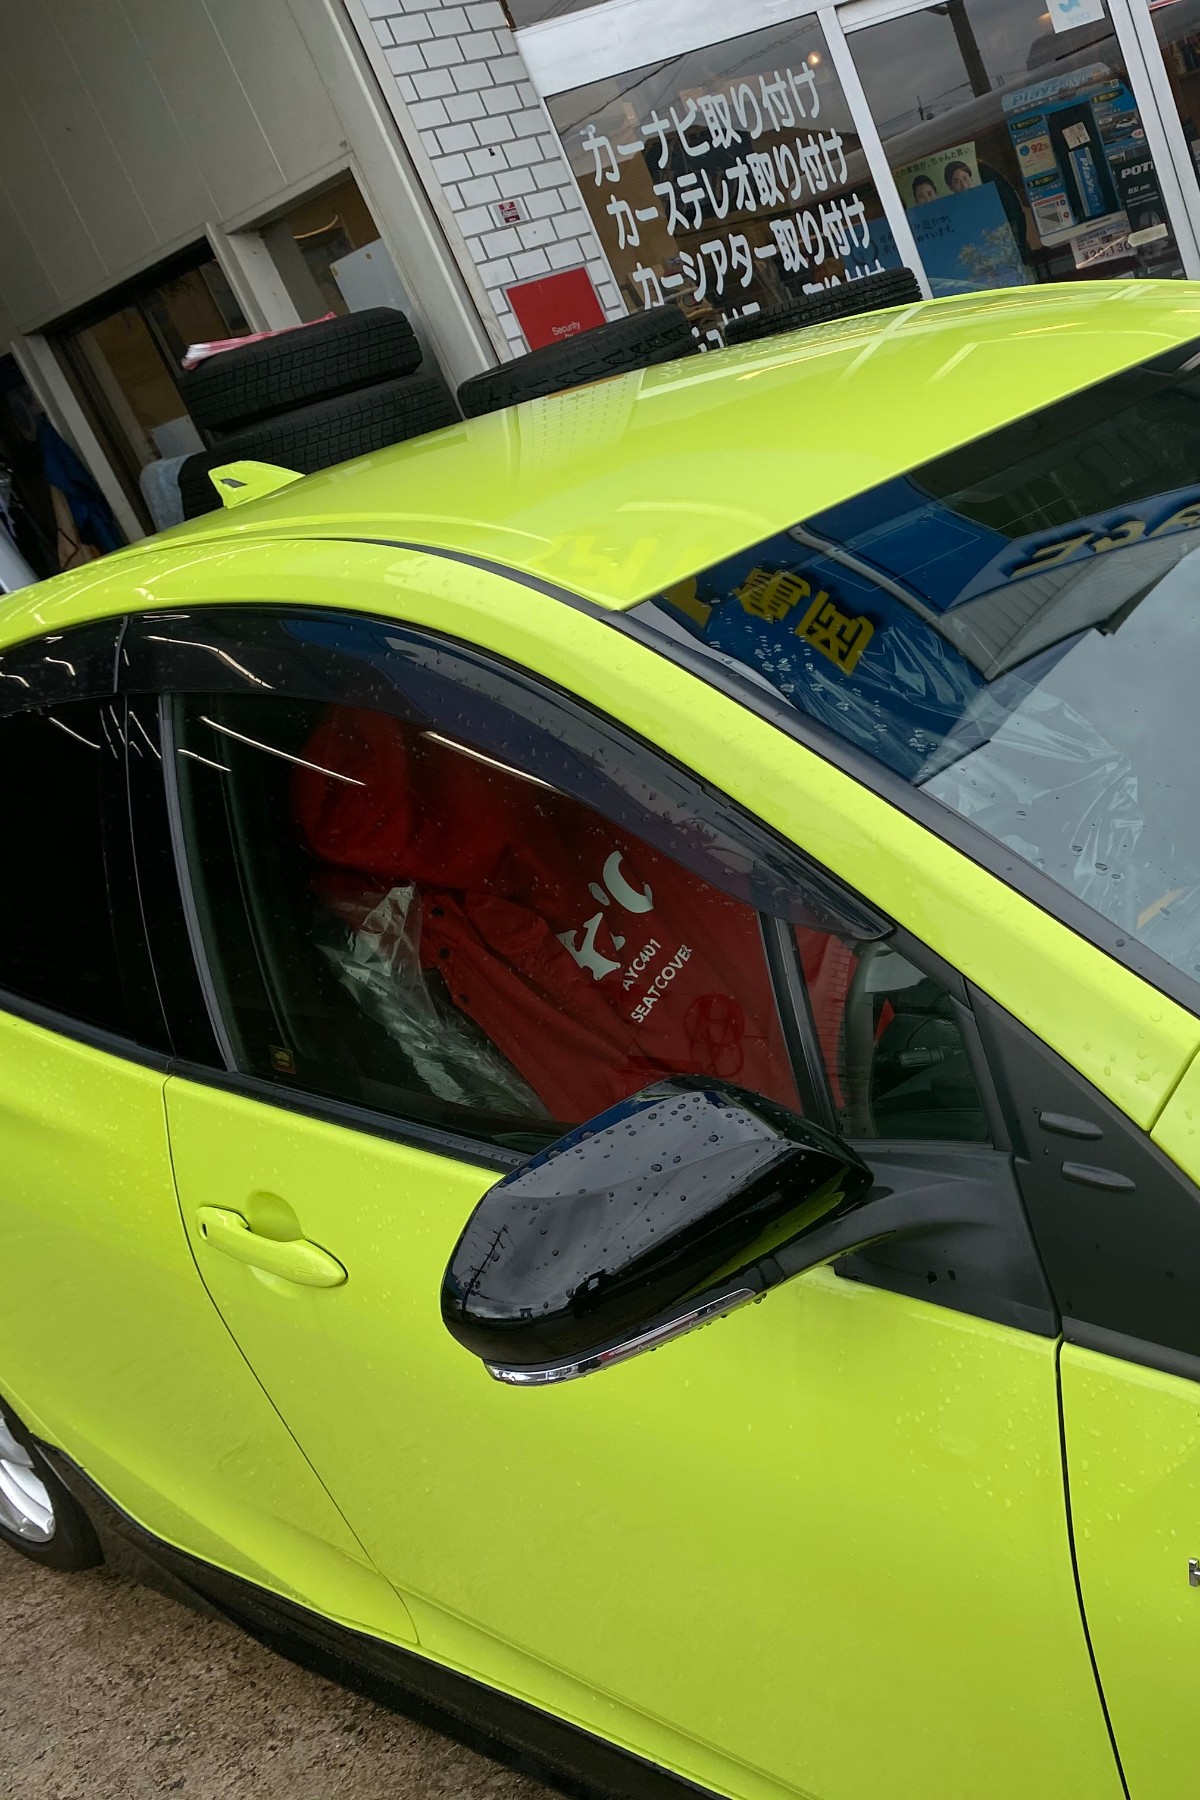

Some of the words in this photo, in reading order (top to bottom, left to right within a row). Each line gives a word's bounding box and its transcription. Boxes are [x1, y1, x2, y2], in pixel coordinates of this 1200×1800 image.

[580, 62, 820, 187] カーナビ取り付け
[606, 128, 848, 249] カーステレオ取り付け
[632, 193, 870, 310] カーシアター取り付け
[551, 321, 581, 336] Security
[622, 938, 662, 991] AYC401
